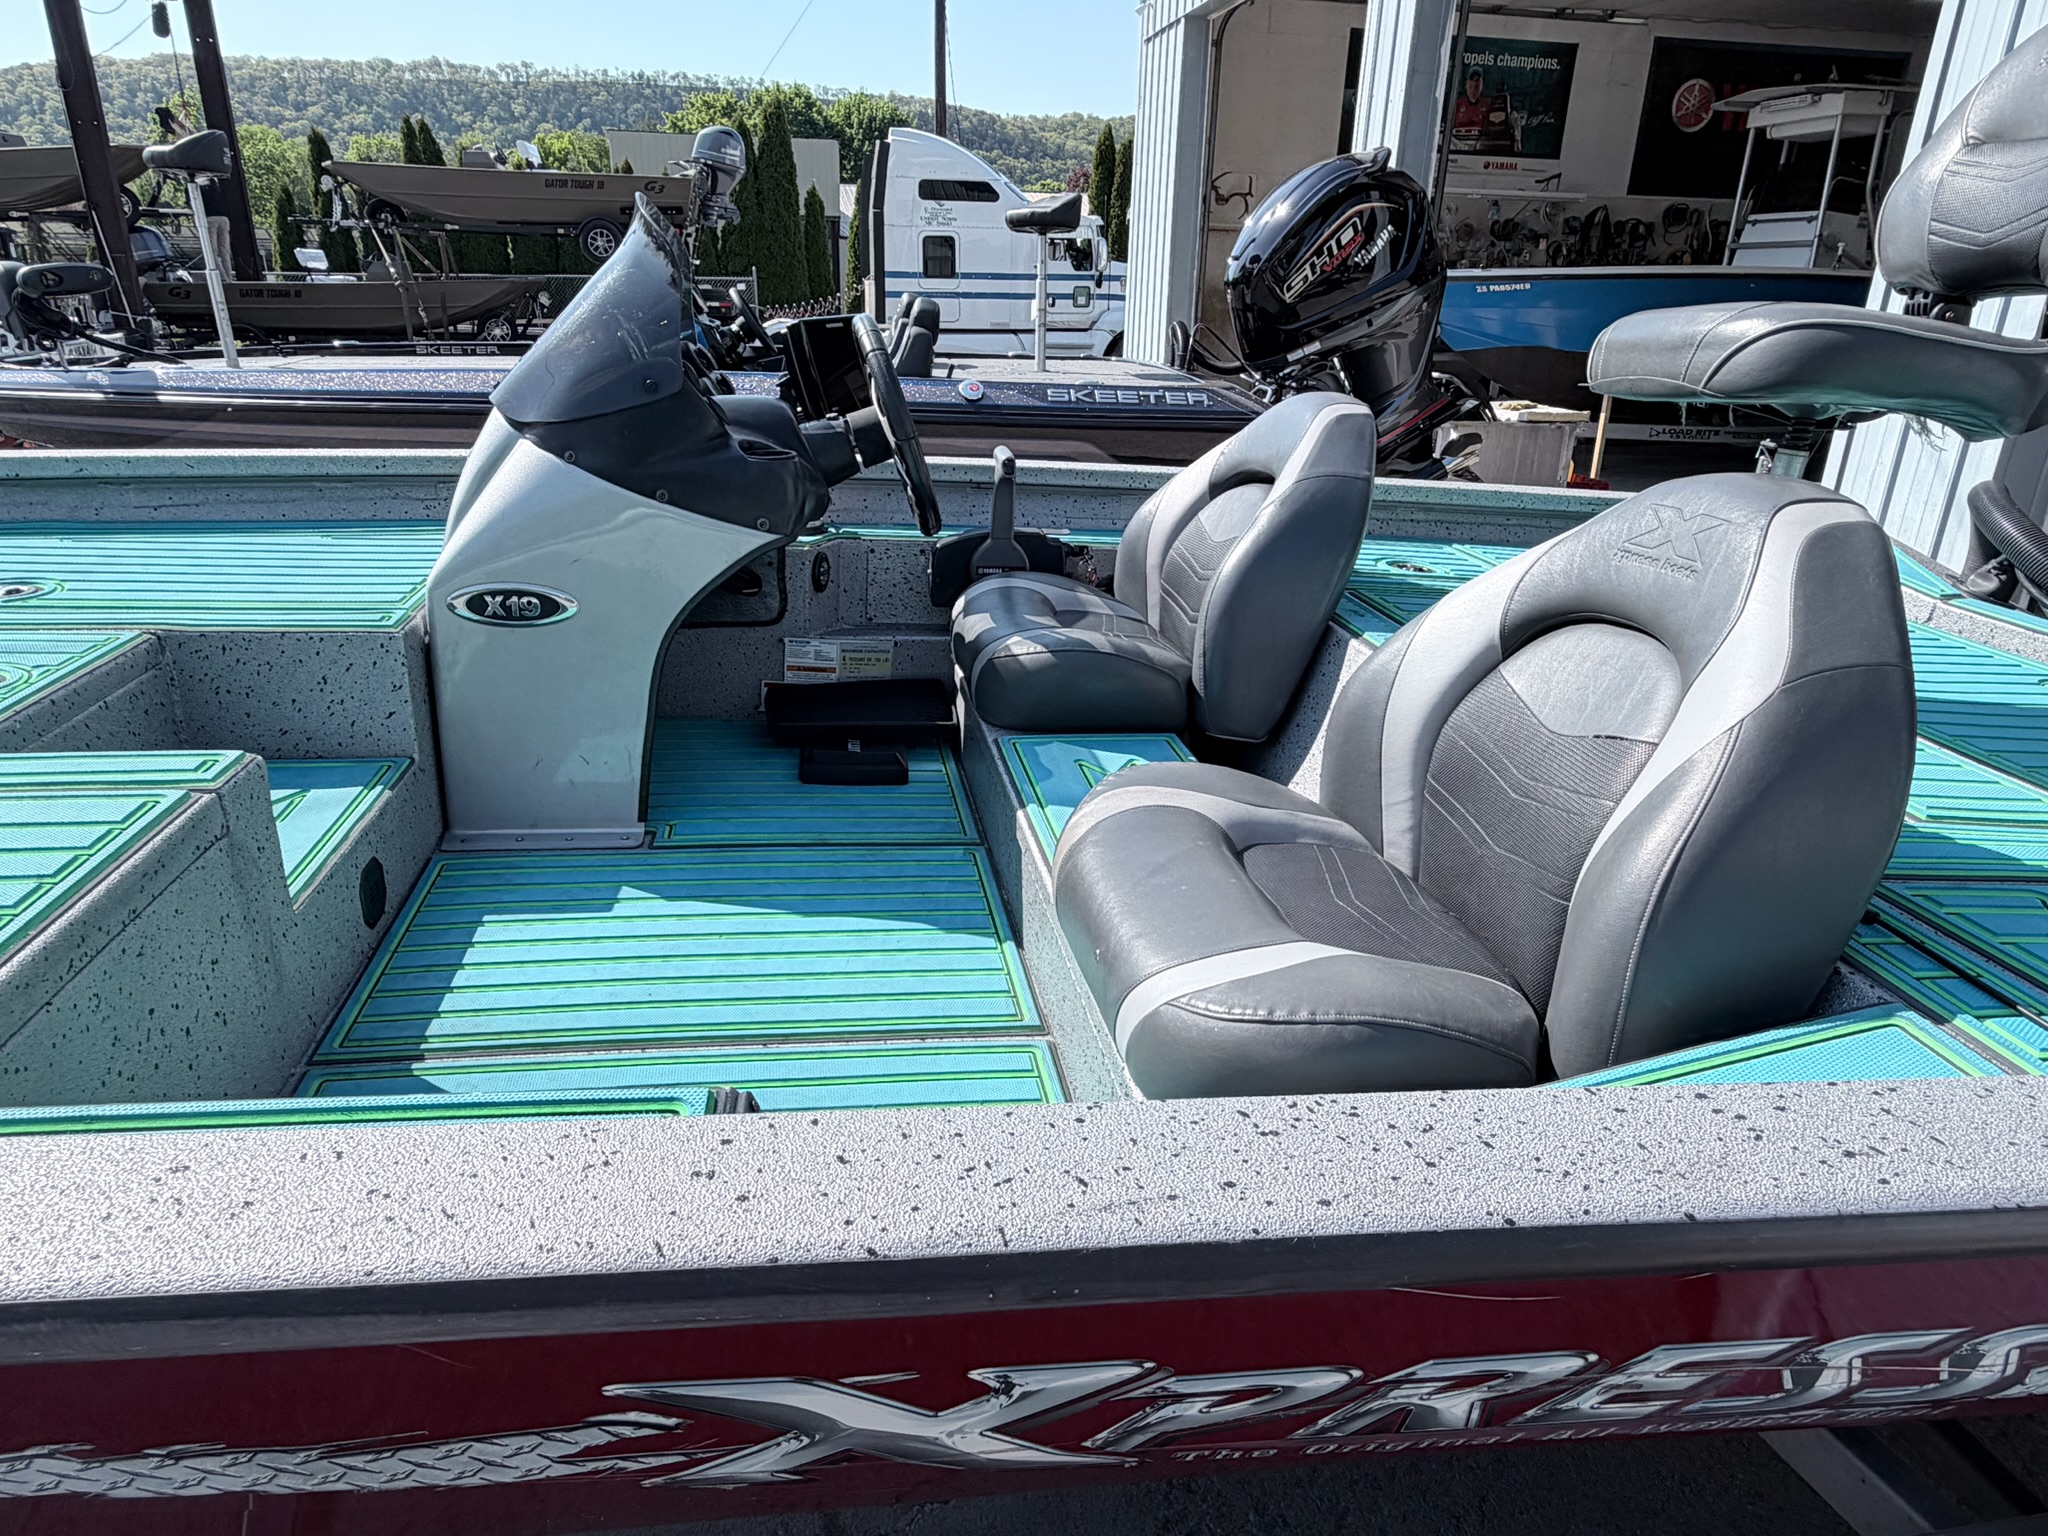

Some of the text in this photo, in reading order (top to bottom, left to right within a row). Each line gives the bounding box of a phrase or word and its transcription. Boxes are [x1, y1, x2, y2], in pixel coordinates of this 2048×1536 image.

[1497, 52, 1560, 71] champions.
[1490, 162, 1518, 171] YAMAHA
[544, 178, 569, 189] GATOR
[570, 179, 594, 190] TOUGH
[643, 180, 666, 194] G3
[1354, 224, 1398, 267] YAMAHA
[1283, 217, 1362, 304] SHO
[168, 286, 192, 300] G3
[239, 288, 265, 298] GATOR
[266, 288, 291, 299] TOUGH
[415, 345, 501, 355] SKEETER
[1047, 387, 1214, 408] SKEETER
[1661, 427, 1694, 436] LOAD
[1695, 429, 1721, 437] RITE
[482, 594, 542, 618] X19
[1171, 1448, 1278, 1463] The
[1299, 1432, 1526, 1456] Original
